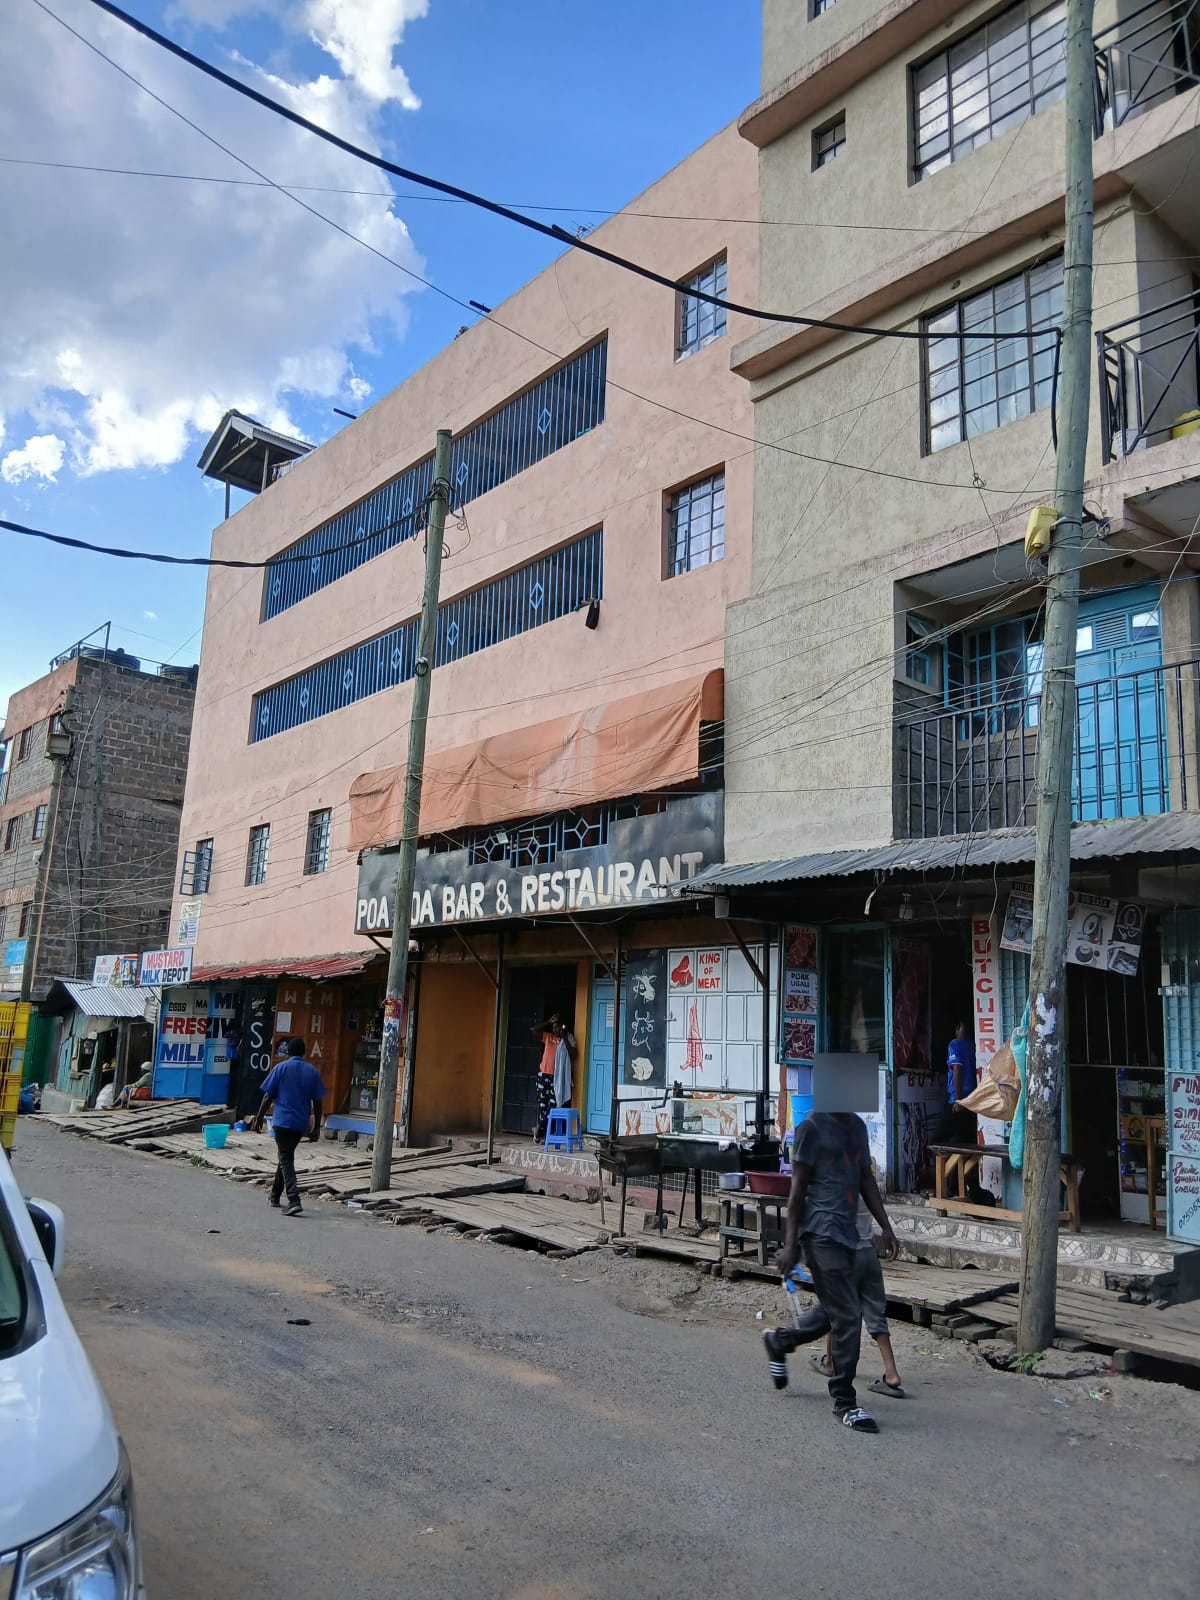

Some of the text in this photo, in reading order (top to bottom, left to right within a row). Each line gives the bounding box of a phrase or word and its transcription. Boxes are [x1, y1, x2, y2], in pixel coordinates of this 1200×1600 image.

[357, 895, 389, 930] POA
[442, 881, 485, 922] BAR
[495, 879, 513, 915] &
[521, 851, 704, 913] RESTAURANT
[147, 951, 184, 969] MUSTARD
[699, 953, 721, 965] KING
[141, 967, 188, 983] MILK DEPOT
[703, 967, 714, 976] OF
[697, 977, 721, 989] MEAT
